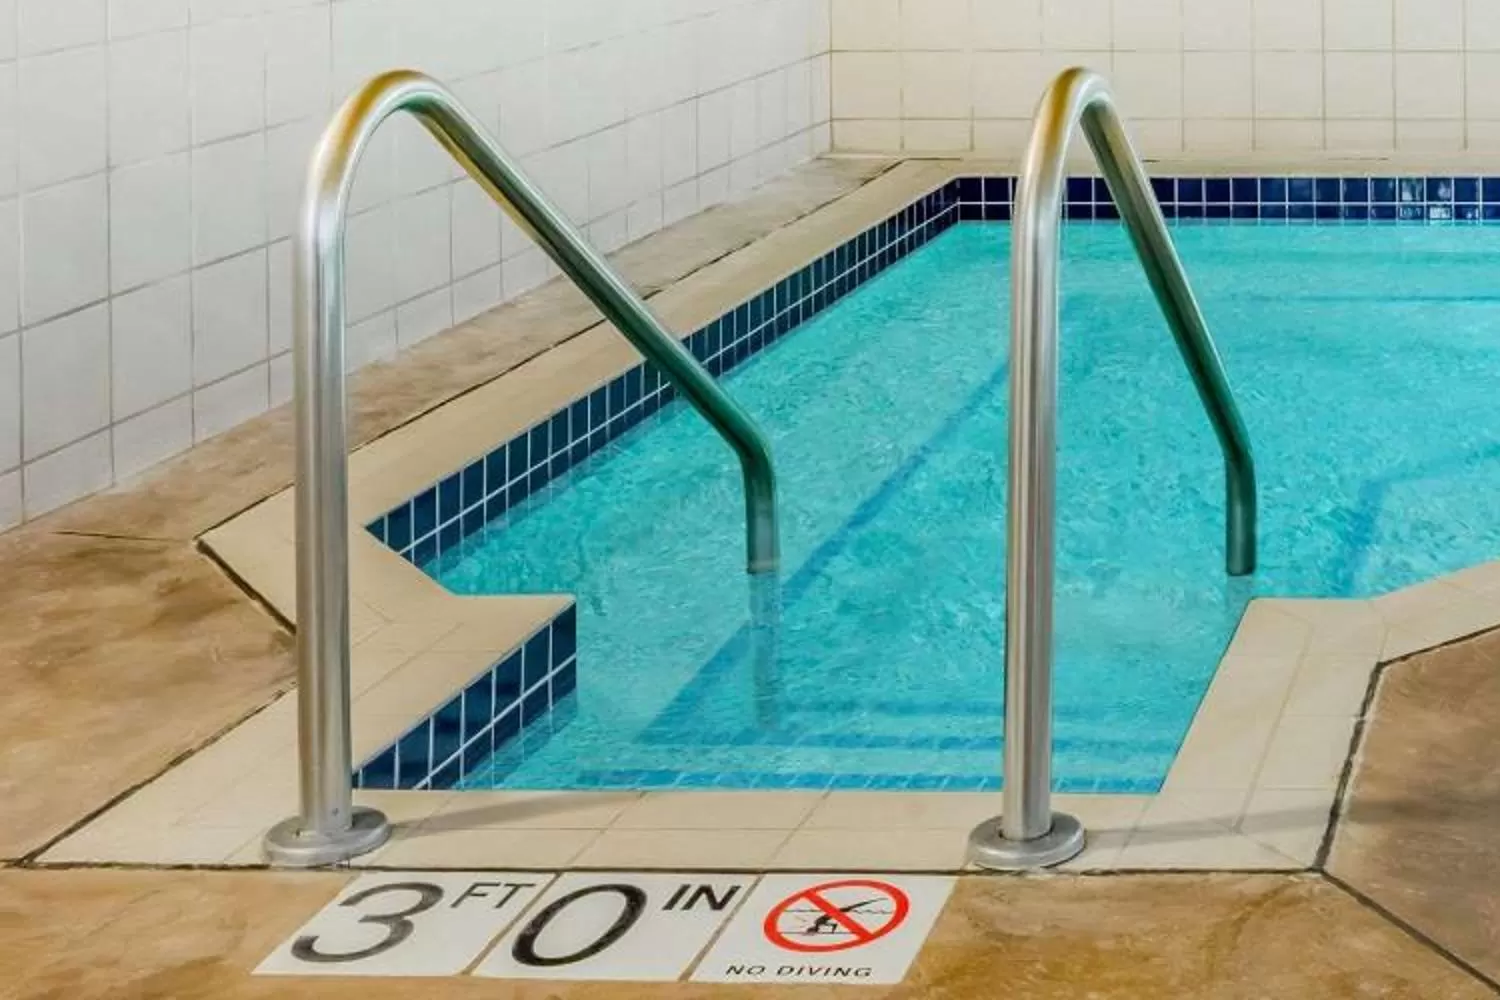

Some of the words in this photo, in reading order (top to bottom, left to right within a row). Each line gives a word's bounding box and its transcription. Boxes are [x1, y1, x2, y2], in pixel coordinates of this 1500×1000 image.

[290, 881, 445, 963] 3
[449, 882, 537, 909] FT
[511, 883, 648, 967] 0
[661, 883, 742, 911] IN
[725, 965, 767, 976] NO
[776, 965, 873, 977] DIVING
